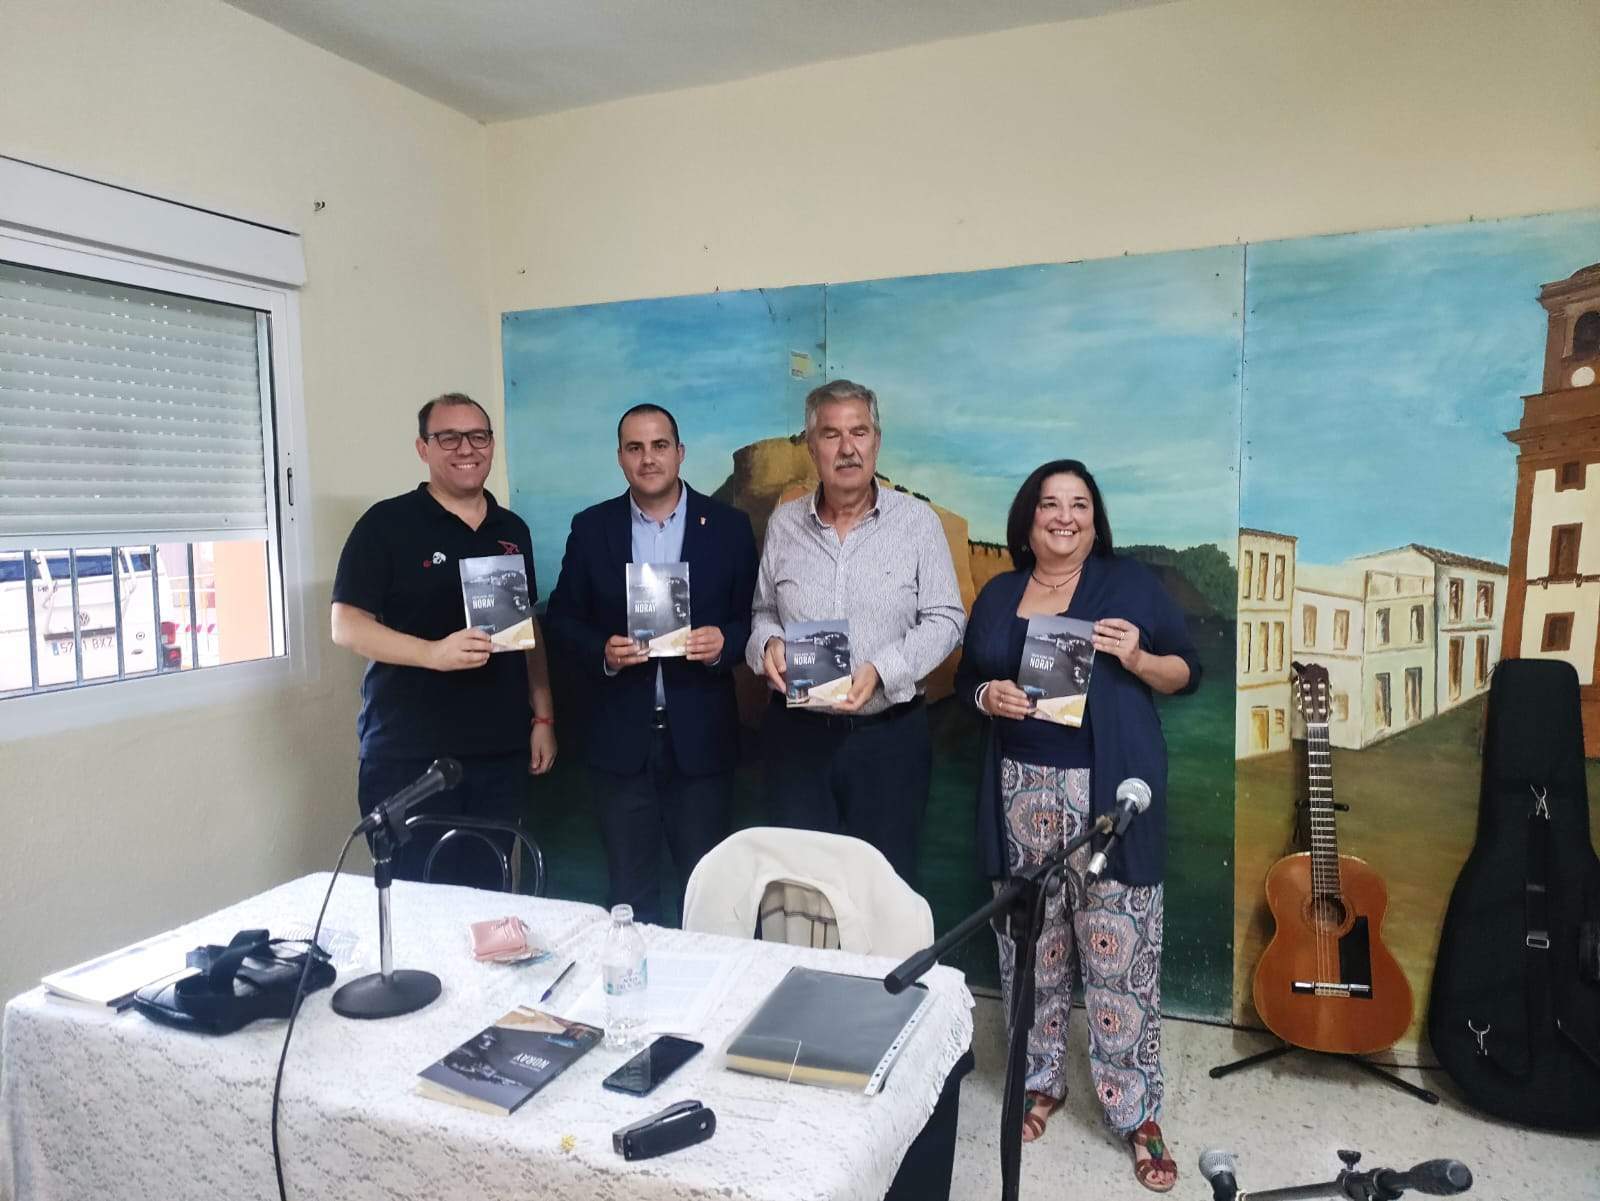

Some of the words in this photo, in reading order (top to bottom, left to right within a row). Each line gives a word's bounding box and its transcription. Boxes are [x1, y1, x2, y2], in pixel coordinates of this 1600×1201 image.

[472, 598, 495, 609] NORAY
[634, 602, 656, 613] NORAY
[60, 639, 88, 653] 571
[793, 655, 816, 666] NORAY
[1029, 656, 1054, 671] NORAY
[512, 1053, 551, 1069] NORAY
